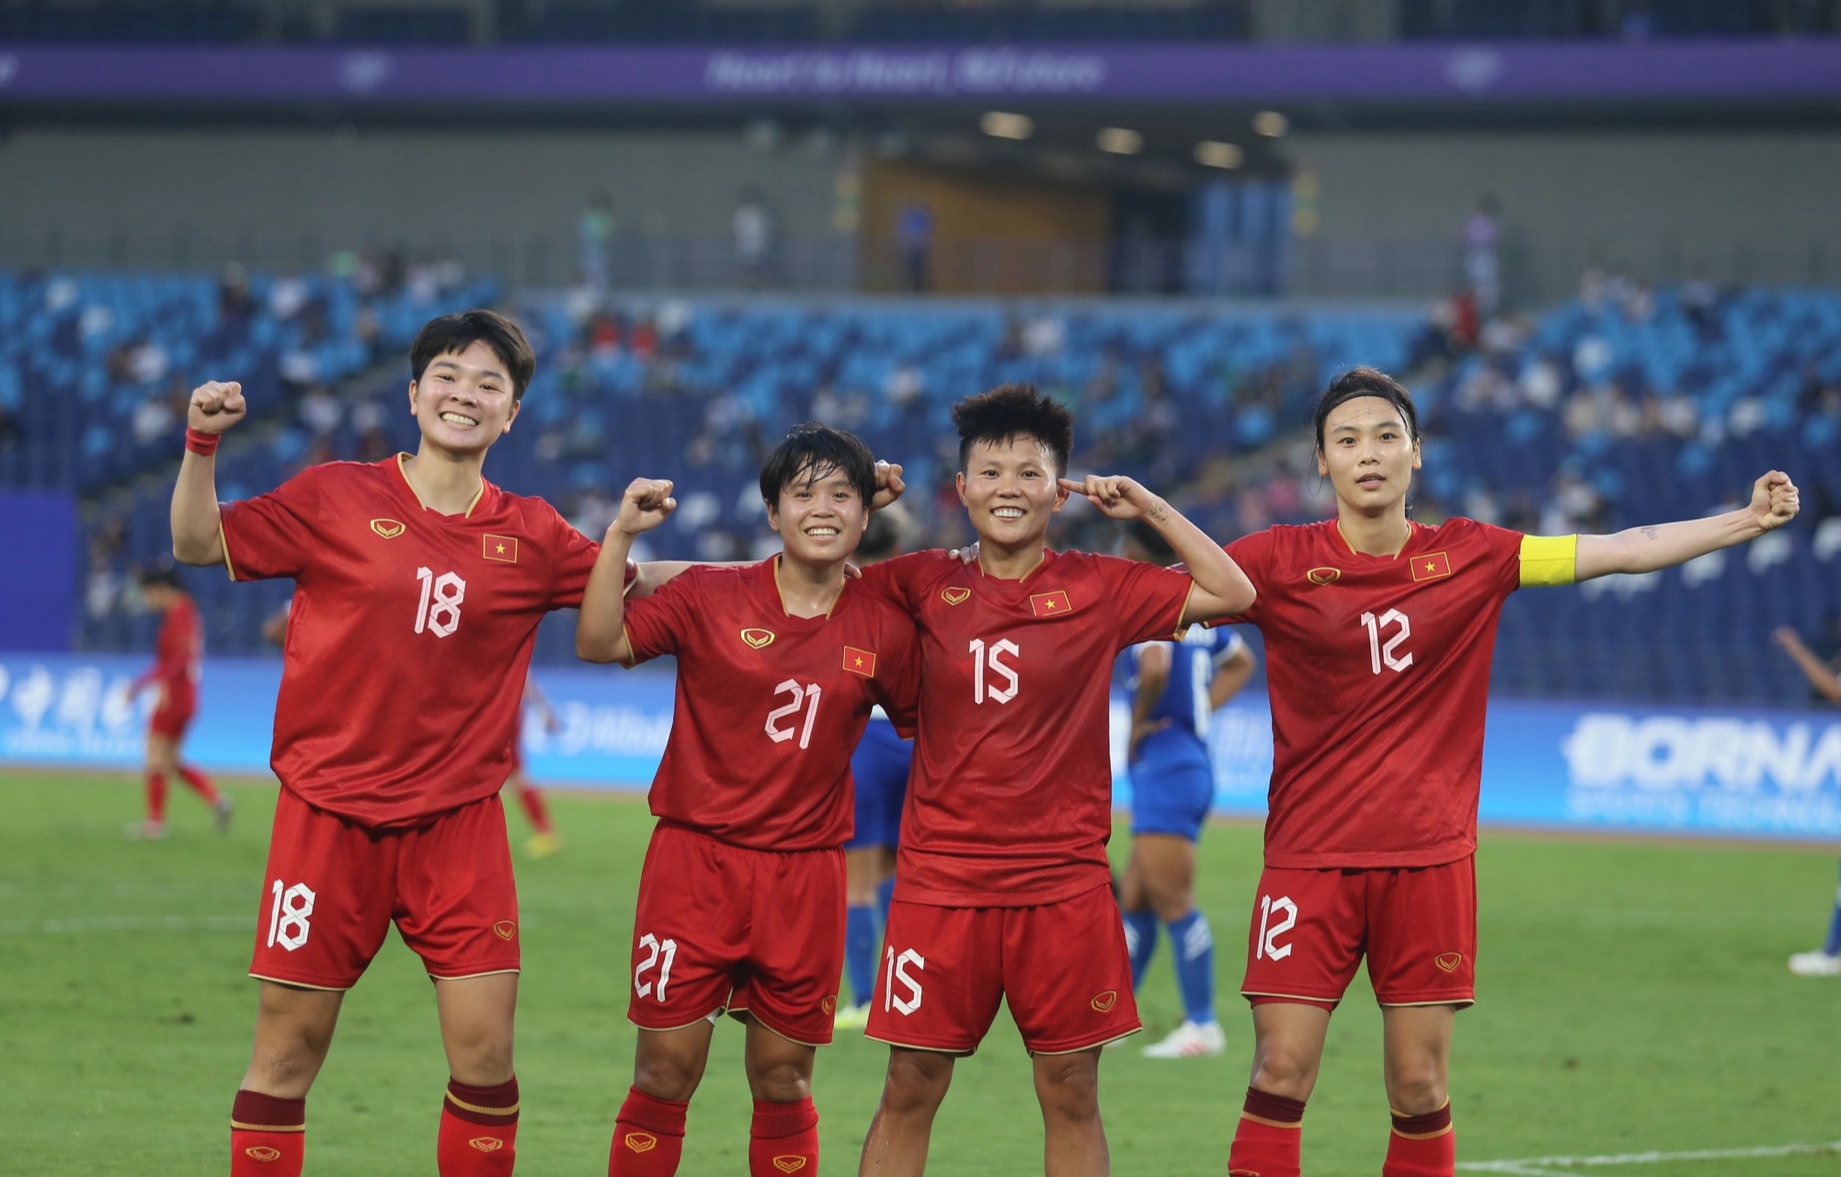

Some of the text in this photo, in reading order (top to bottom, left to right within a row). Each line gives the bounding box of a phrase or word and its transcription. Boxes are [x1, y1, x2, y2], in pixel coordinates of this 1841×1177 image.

[414, 566, 467, 639] 18
[968, 637, 1020, 705] 15
[1360, 607, 1414, 675] 12
[764, 678, 822, 750] 21
[267, 878, 316, 952] 18
[1256, 894, 1298, 962] 12
[634, 932, 678, 1003] 21
[884, 944, 925, 1016] 15
